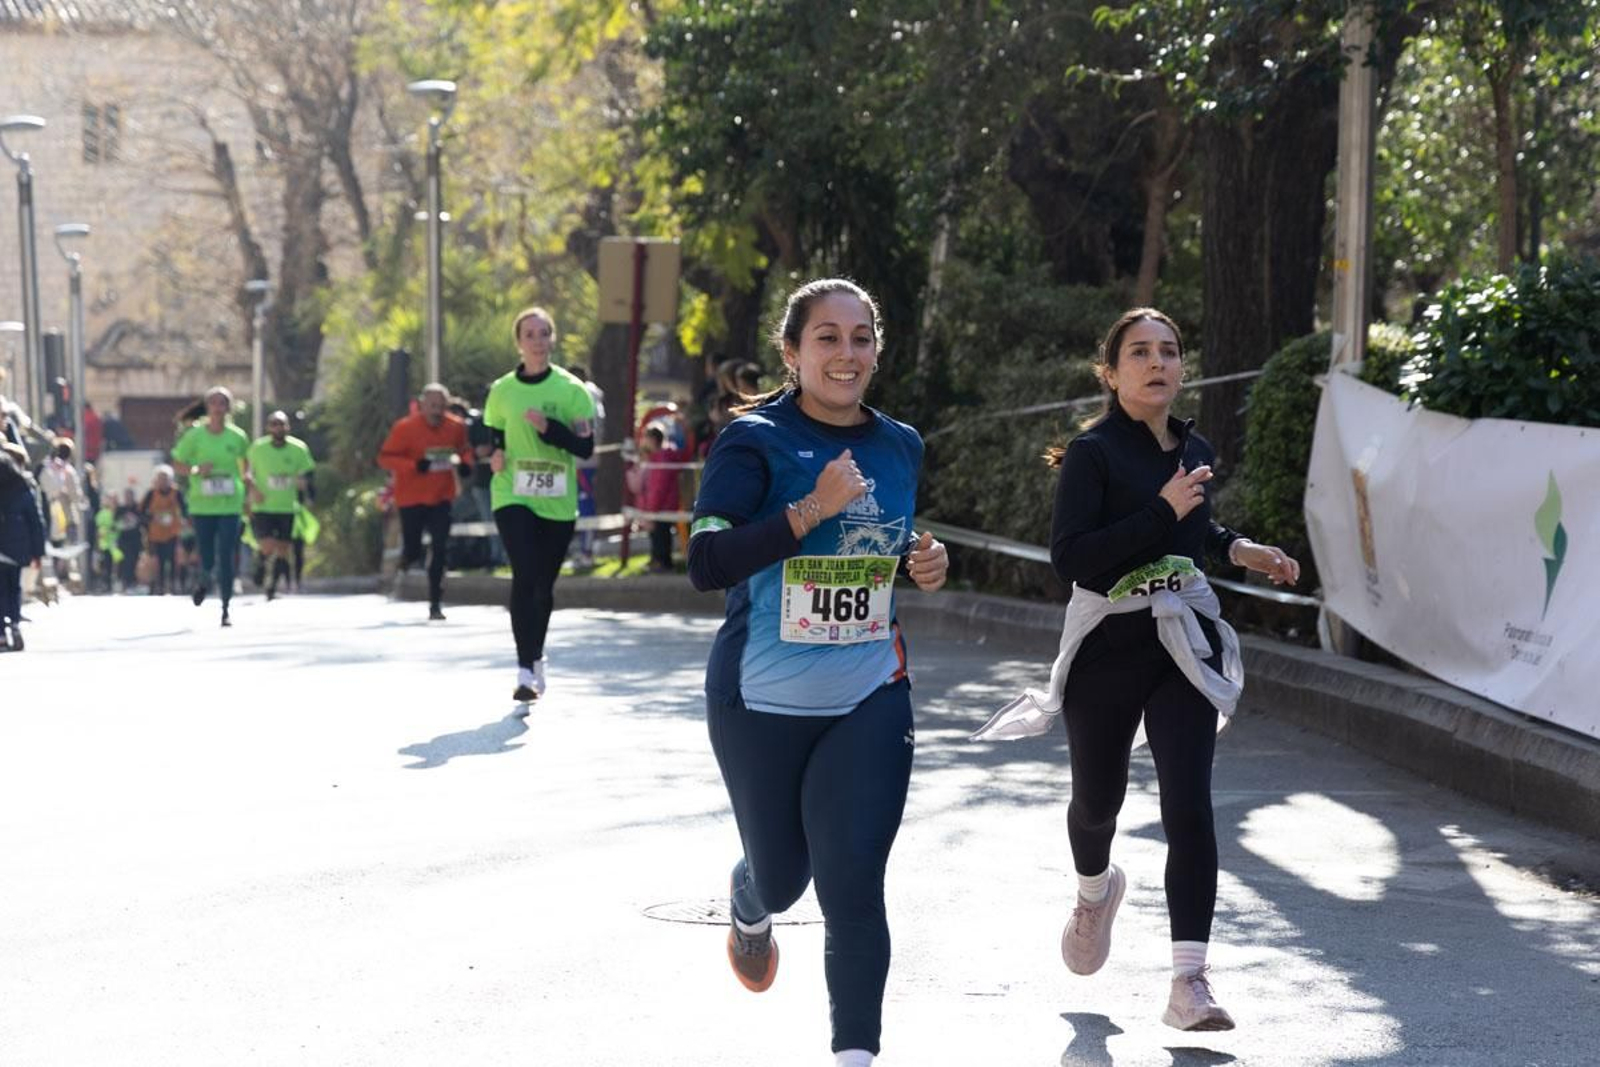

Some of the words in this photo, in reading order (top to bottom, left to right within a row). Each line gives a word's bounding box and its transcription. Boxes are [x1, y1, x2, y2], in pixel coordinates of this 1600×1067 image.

[526, 473, 554, 489] 758
[808, 559, 823, 570] SAN
[825, 558, 845, 572] JUAN
[802, 571, 832, 584] CARRERA
[811, 587, 870, 622] 468
